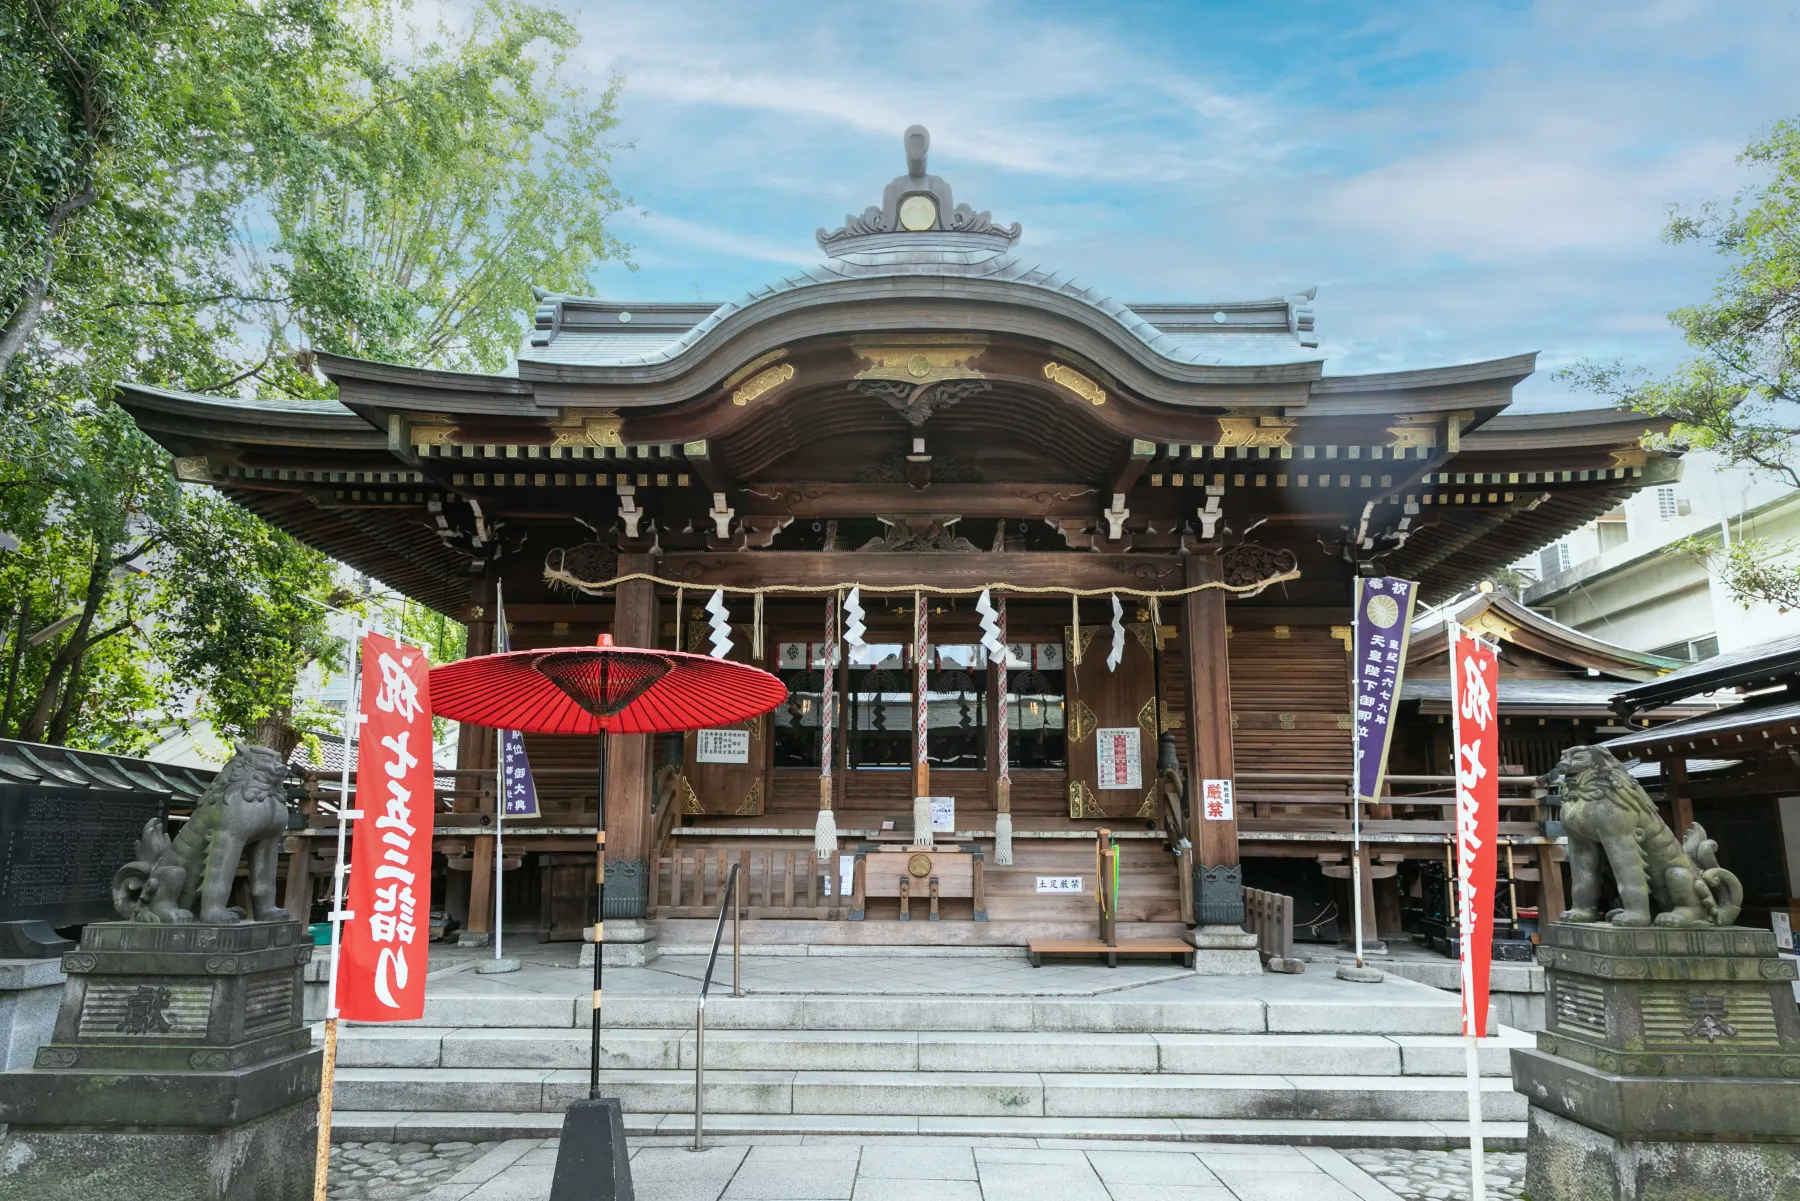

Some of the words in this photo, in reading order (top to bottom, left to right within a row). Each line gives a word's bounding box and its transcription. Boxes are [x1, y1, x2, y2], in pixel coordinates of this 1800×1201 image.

[1368, 577, 1408, 595] 奉祝
[1357, 634, 1386, 738] 天皇陛下御即位
[1374, 639, 1399, 725] 皇紀二六七九年
[505, 742, 514, 811] 東京都神社庁
[514, 767, 526, 812] 御大典
[1207, 784, 1223, 817] 厳禁
[1038, 879, 1080, 889] 土足厳禁
[1683, 991, 1738, 1043] 奉
